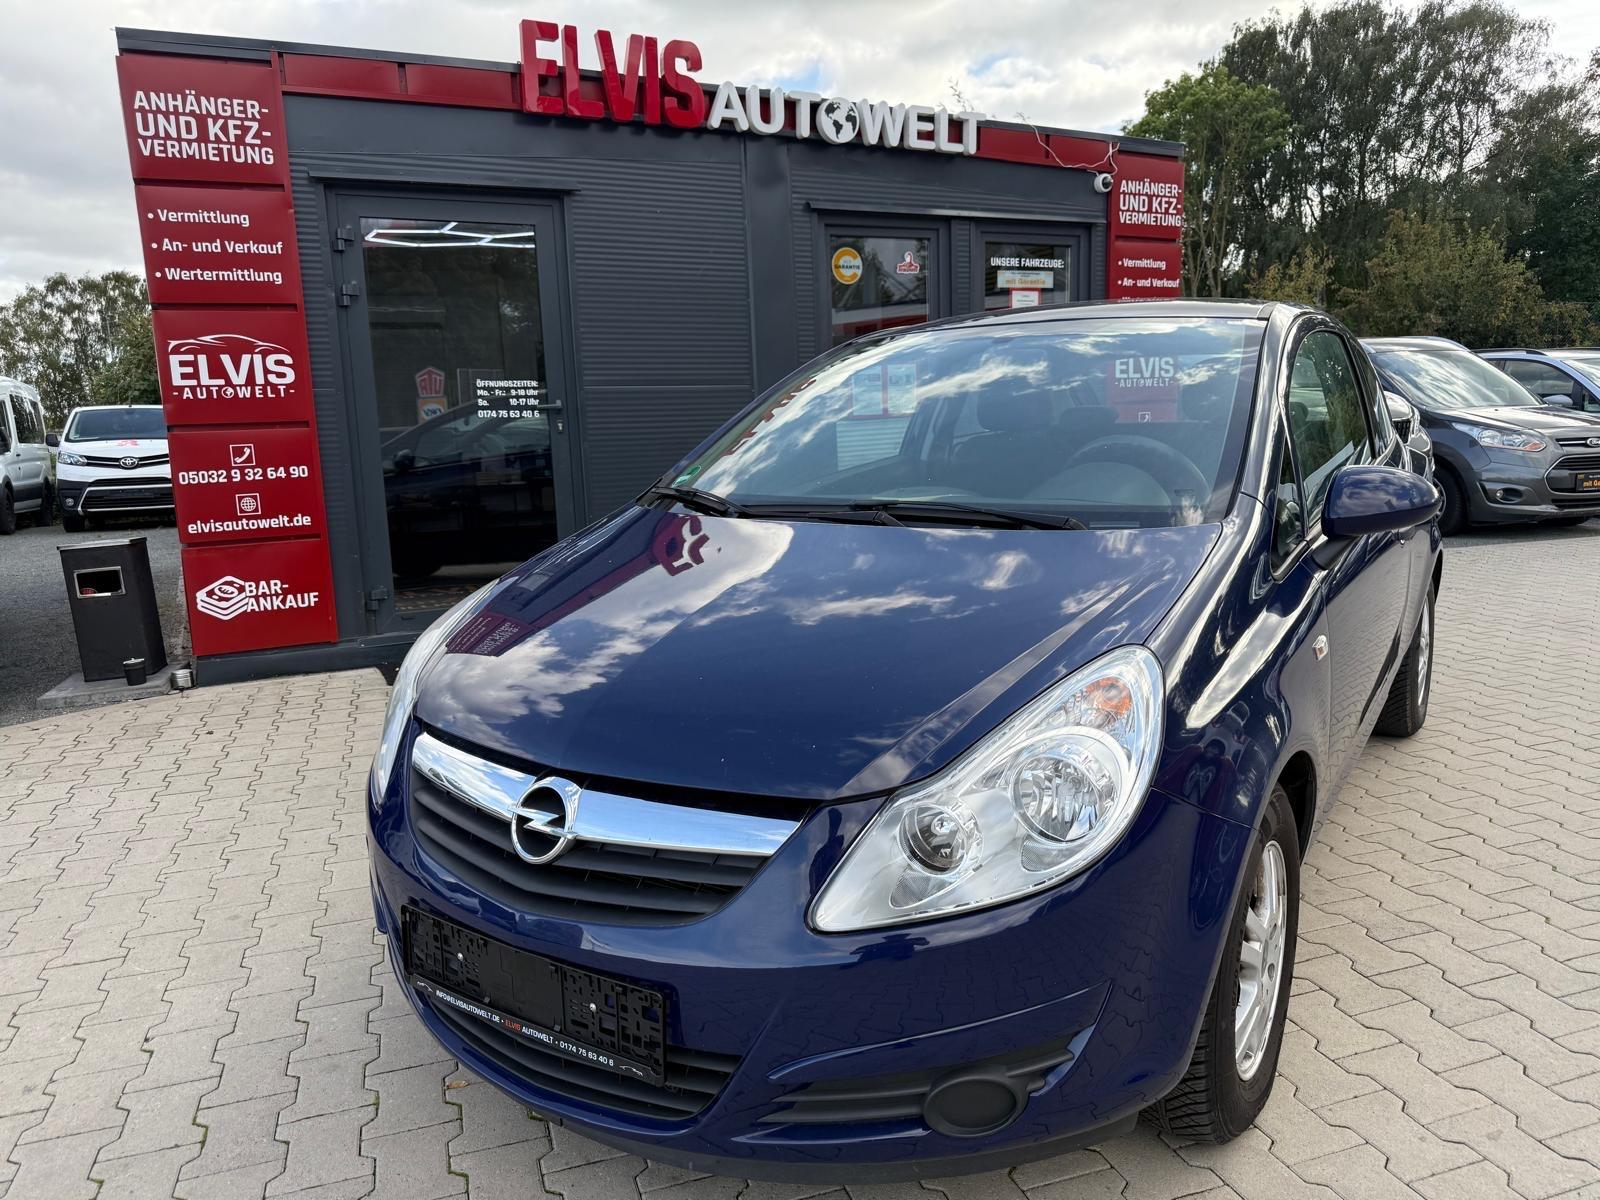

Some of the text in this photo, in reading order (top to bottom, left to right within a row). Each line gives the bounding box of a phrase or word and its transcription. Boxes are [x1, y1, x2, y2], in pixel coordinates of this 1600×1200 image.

[519, 18, 986, 156] ELVIS AUTOWELT
[134, 90, 269, 118] ANHÄNGER-
[135, 112, 271, 144] UND KFZ-
[138, 138, 274, 164] VERMIETUNG
[1120, 179, 1182, 197] ANHÄNGER-
[1120, 194, 1182, 214] UND KFZ-
[157, 209, 250, 227] Vermittlung
[1119, 211, 1181, 227] VERMIETUNG
[162, 238, 283, 255] An- und Verkauf
[990, 257, 1064, 268] UNSERE FAHRZEUGE:
[1122, 258, 1166, 270] Vermittlung
[165, 268, 283, 285] Wertermittlung
[1122, 277, 1180, 288] An- und Verkauf
[169, 354, 296, 386] ELVIS
[1114, 357, 1175, 378] ELVIS
[476, 378, 538, 388] ÖFFNUNGSZEITEN:
[526, 388, 538, 396] Uhr
[510, 398, 526, 406] 10-17
[527, 398, 540, 406] Uhr
[478, 410, 540, 418] 0174 75 63 40 6
[178, 466, 308, 485] 05032 9 32 64 90
[188, 514, 312, 534] elvisautowelt.de
[244, 580, 289, 596] BAR-
[246, 592, 319, 612] ANKAUF
[436, 990, 500, 1023] INFO@ELVISAUTOWELT.DE
[506, 1019, 521, 1031] ELVIS
[522, 1026, 554, 1044] AUTOWELT
[560, 1041, 576, 1053] 0174
[578, 1048, 587, 1057] 75
[588, 1051, 597, 1060] 63
[598, 1055, 608, 1064] 40
